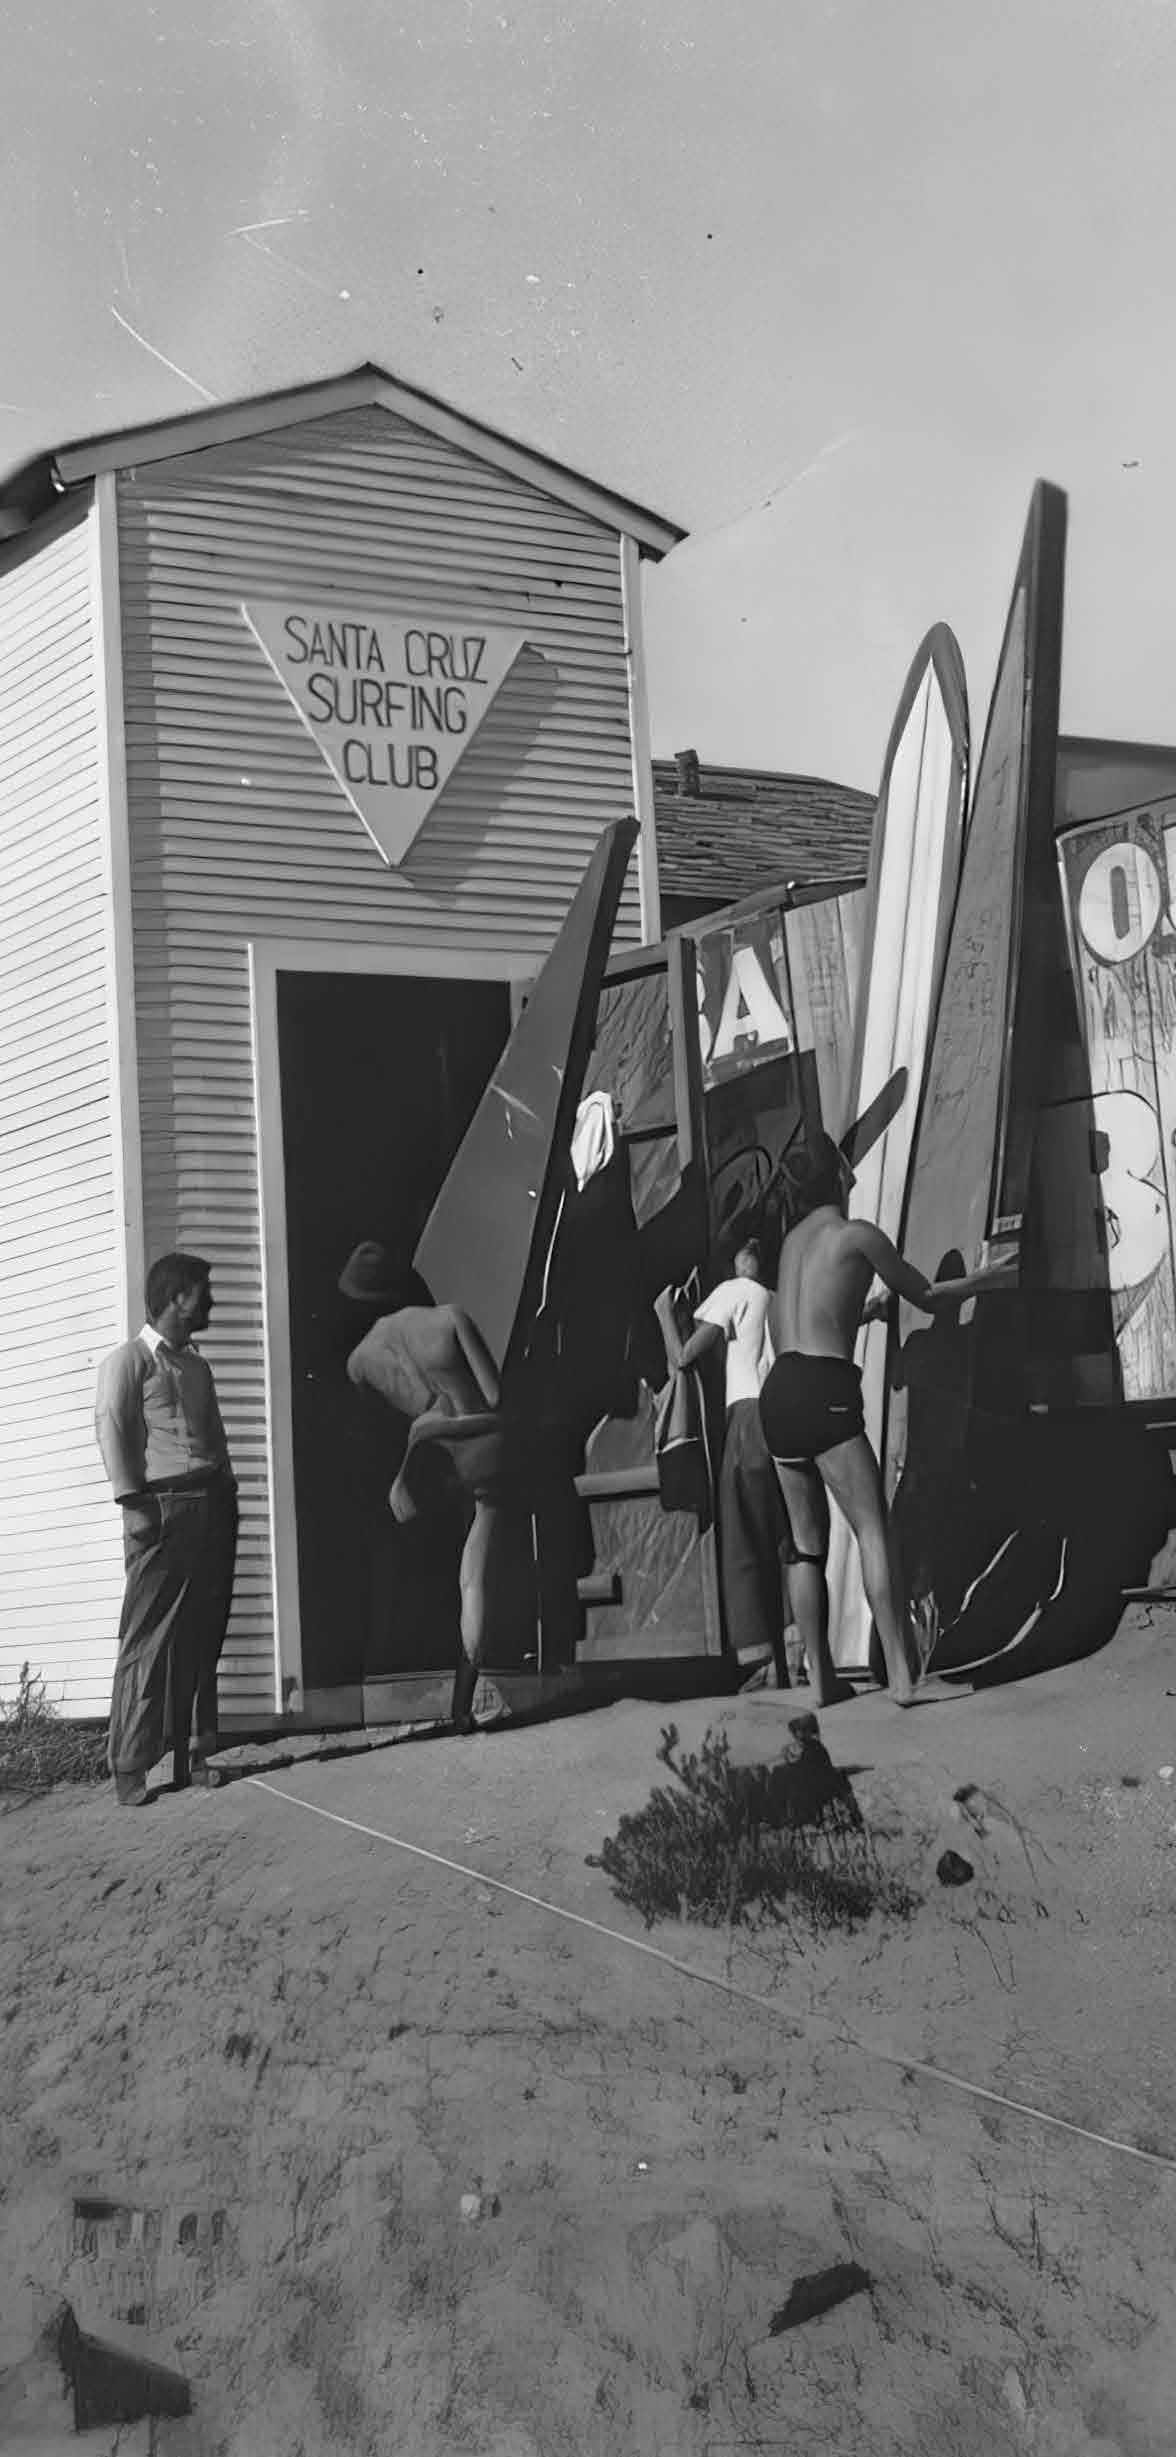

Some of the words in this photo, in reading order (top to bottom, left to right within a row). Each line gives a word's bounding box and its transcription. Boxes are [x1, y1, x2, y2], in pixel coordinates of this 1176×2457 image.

[284, 615, 385, 673] SANTA
[404, 629, 488, 684] CRUZ
[307, 672, 467, 735] SURFING
[342, 738, 439, 790] CLUB
